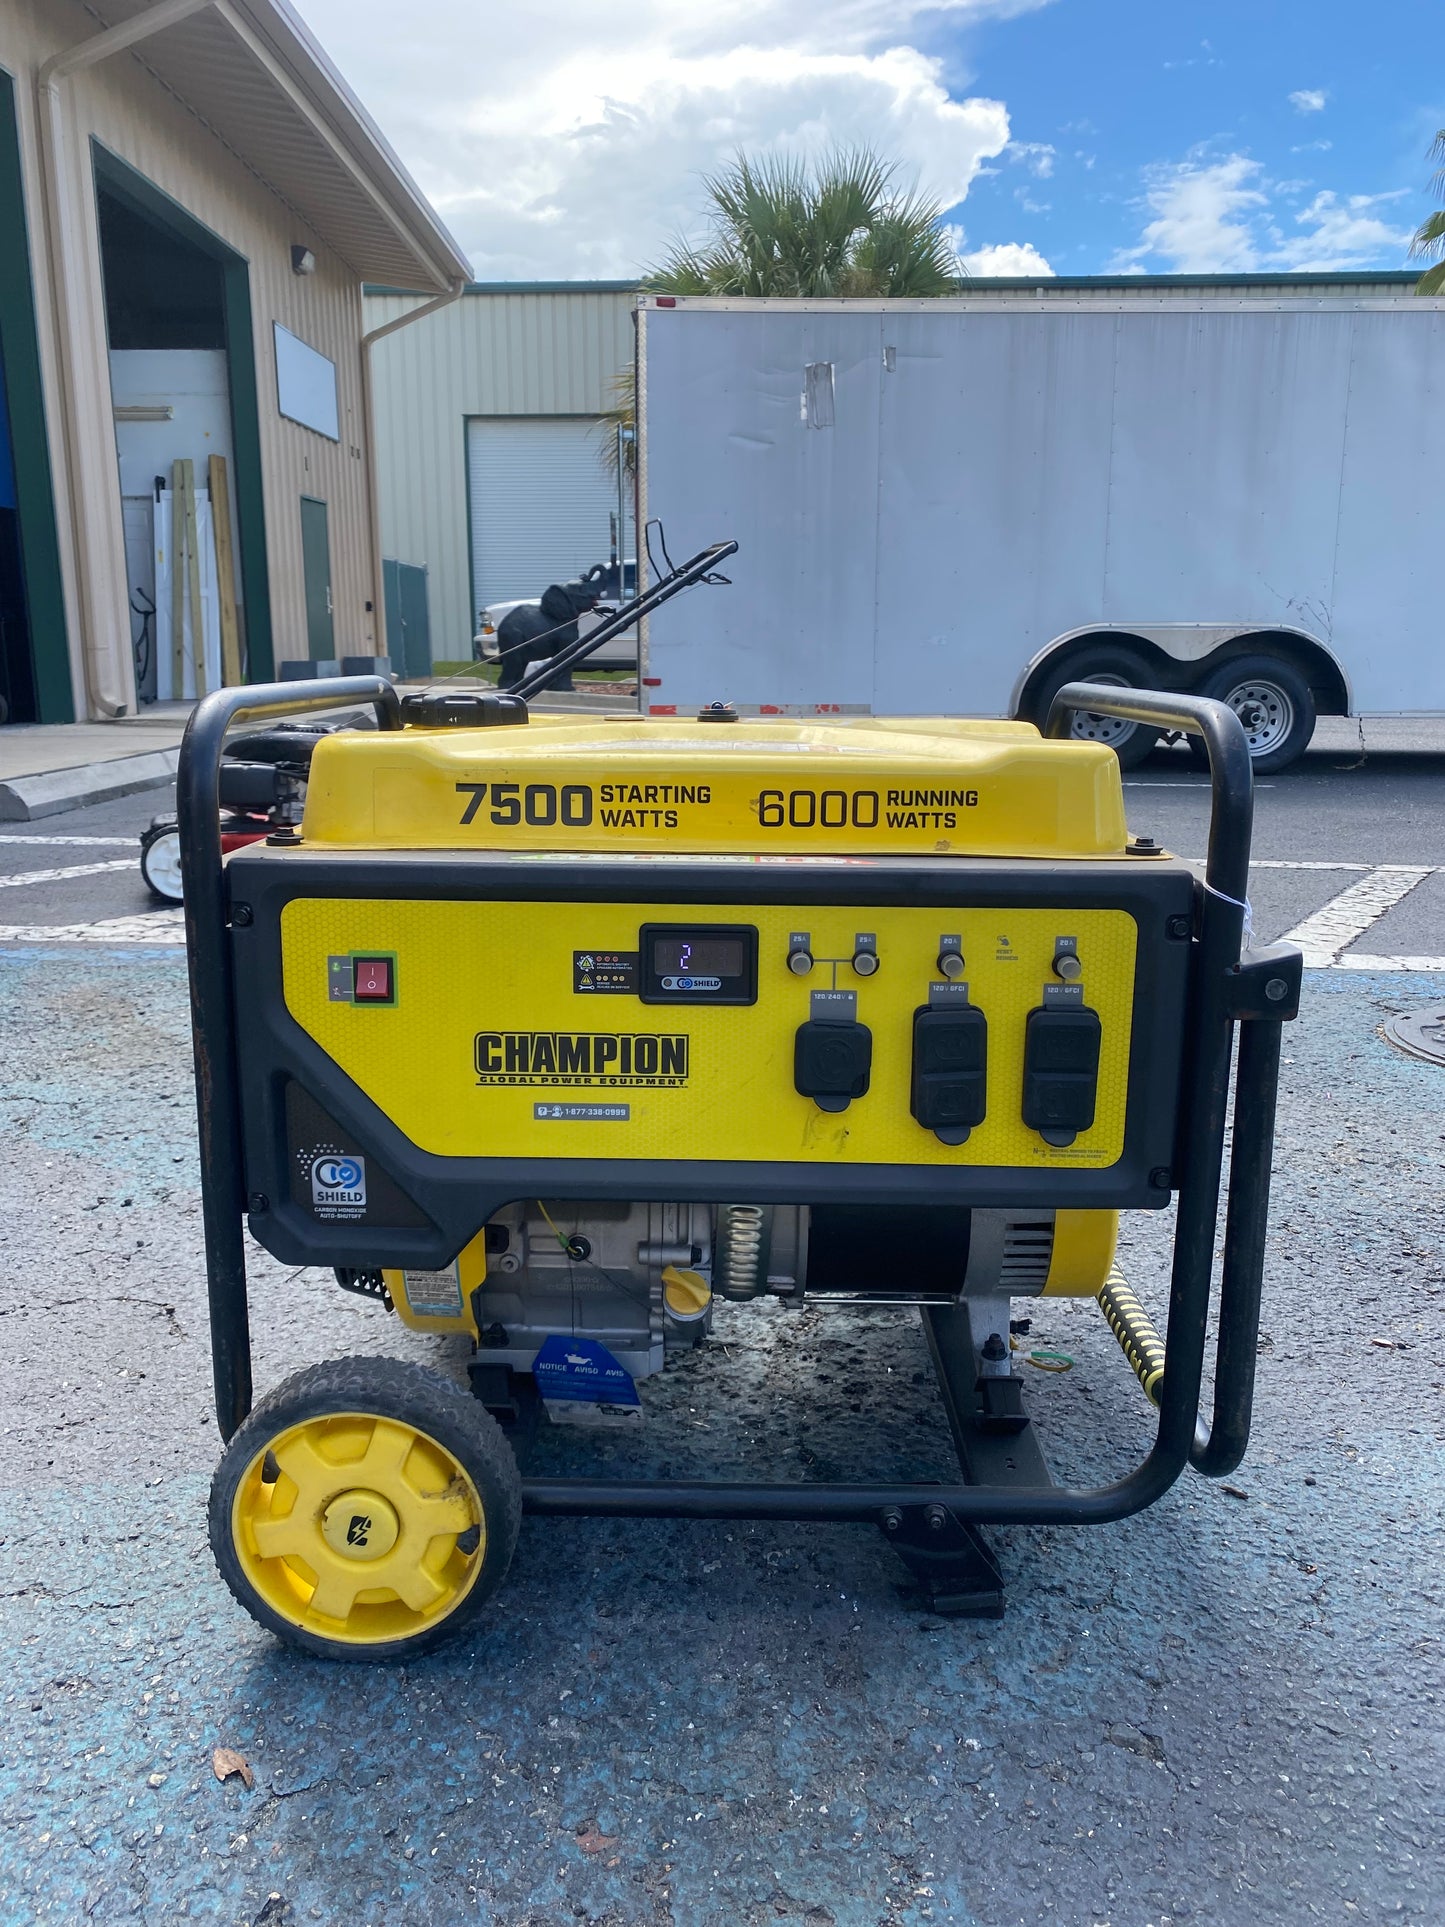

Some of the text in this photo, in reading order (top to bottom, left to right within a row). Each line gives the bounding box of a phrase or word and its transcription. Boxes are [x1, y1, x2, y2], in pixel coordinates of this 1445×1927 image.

[456, 783, 711, 826] 7500 STARTING
[758, 789, 979, 827] 6000 RUNNING
[600, 809, 678, 828] WATTS
[886, 812, 957, 829] WATTS
[681, 944, 691, 969] 2
[694, 979, 721, 987] SHIELD
[474, 1031, 690, 1078] CHAMPION
[479, 1076, 686, 1086] GLOBAL POWER EQUIPMENT
[565, 1108, 626, 1117] 1-877-338-0999
[317, 1191, 363, 1202] SHIELD
[539, 1362, 625, 1377] NOTICE AVISO AVIS
